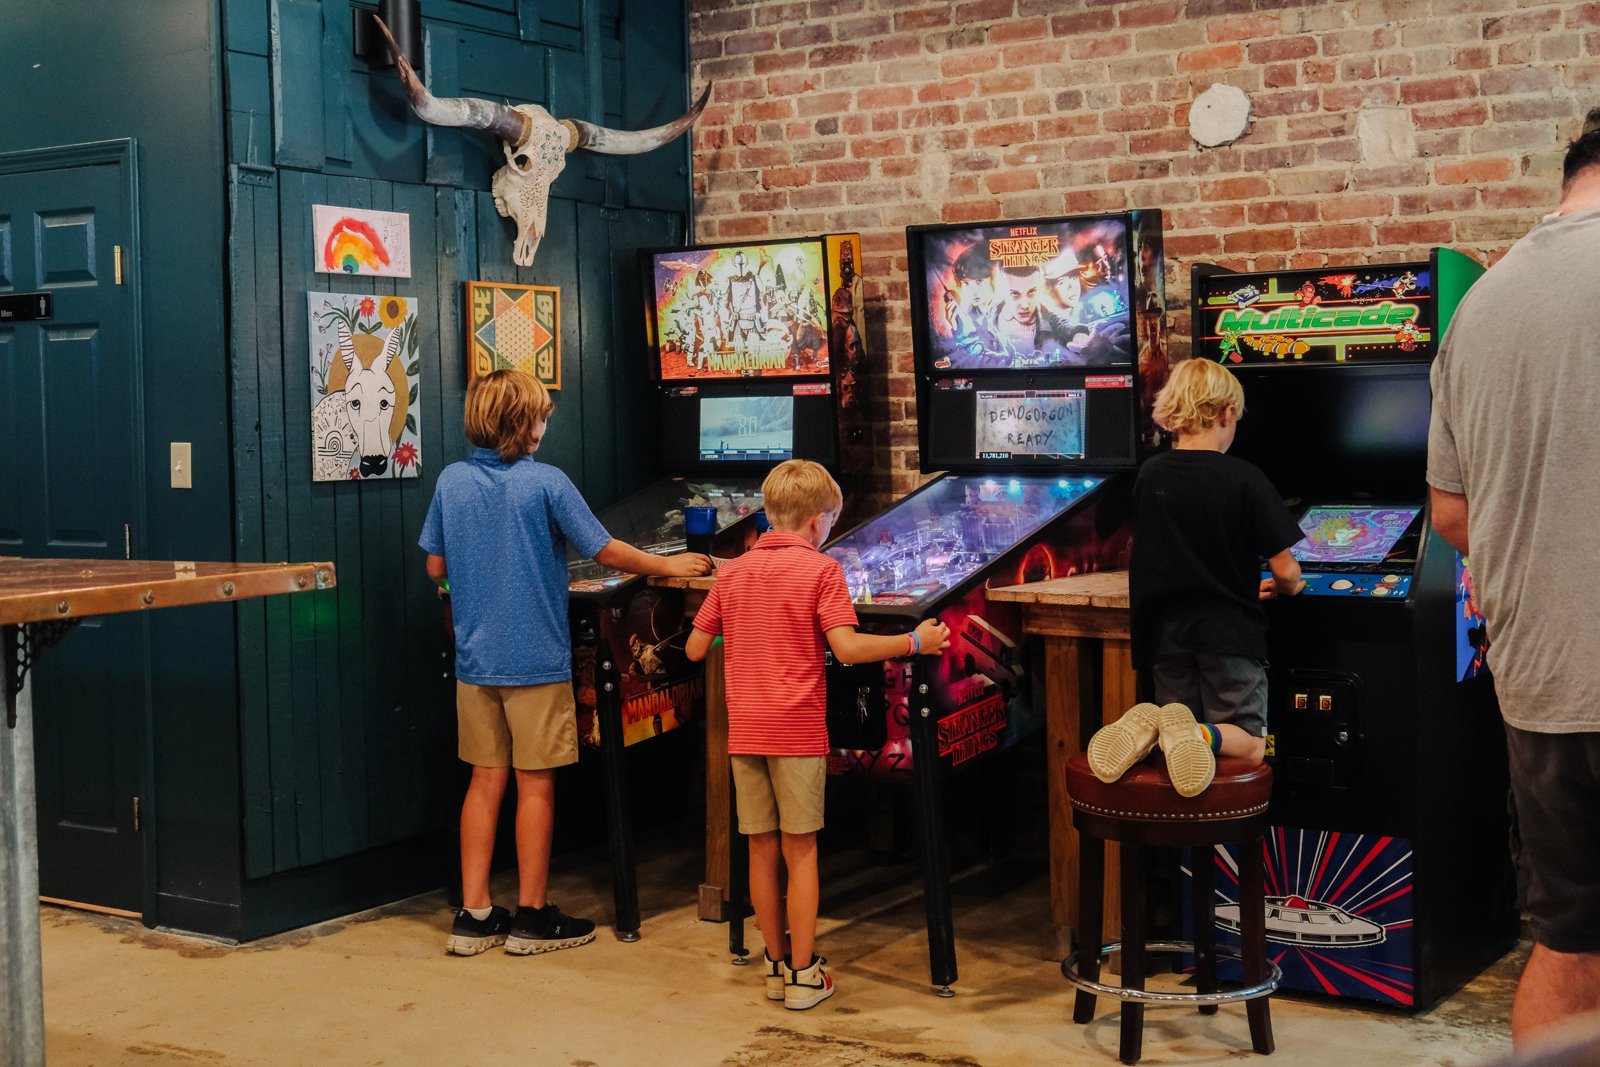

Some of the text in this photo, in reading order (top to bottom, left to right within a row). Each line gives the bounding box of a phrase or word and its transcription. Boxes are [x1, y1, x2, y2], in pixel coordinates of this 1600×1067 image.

[1010, 226, 1038, 237] NETFLIX
[989, 237, 1060, 258] STRANGER
[1002, 253, 1050, 268] THINGS
[0, 309, 13, 318] Men
[1218, 304, 1416, 333] Multicade
[707, 350, 787, 371] MANDALORIAN
[989, 402, 1073, 424] DEMOGORGON
[1007, 430, 1054, 447] READY
[938, 698, 1007, 752] STRANGER
[951, 730, 998, 767] THINGS
